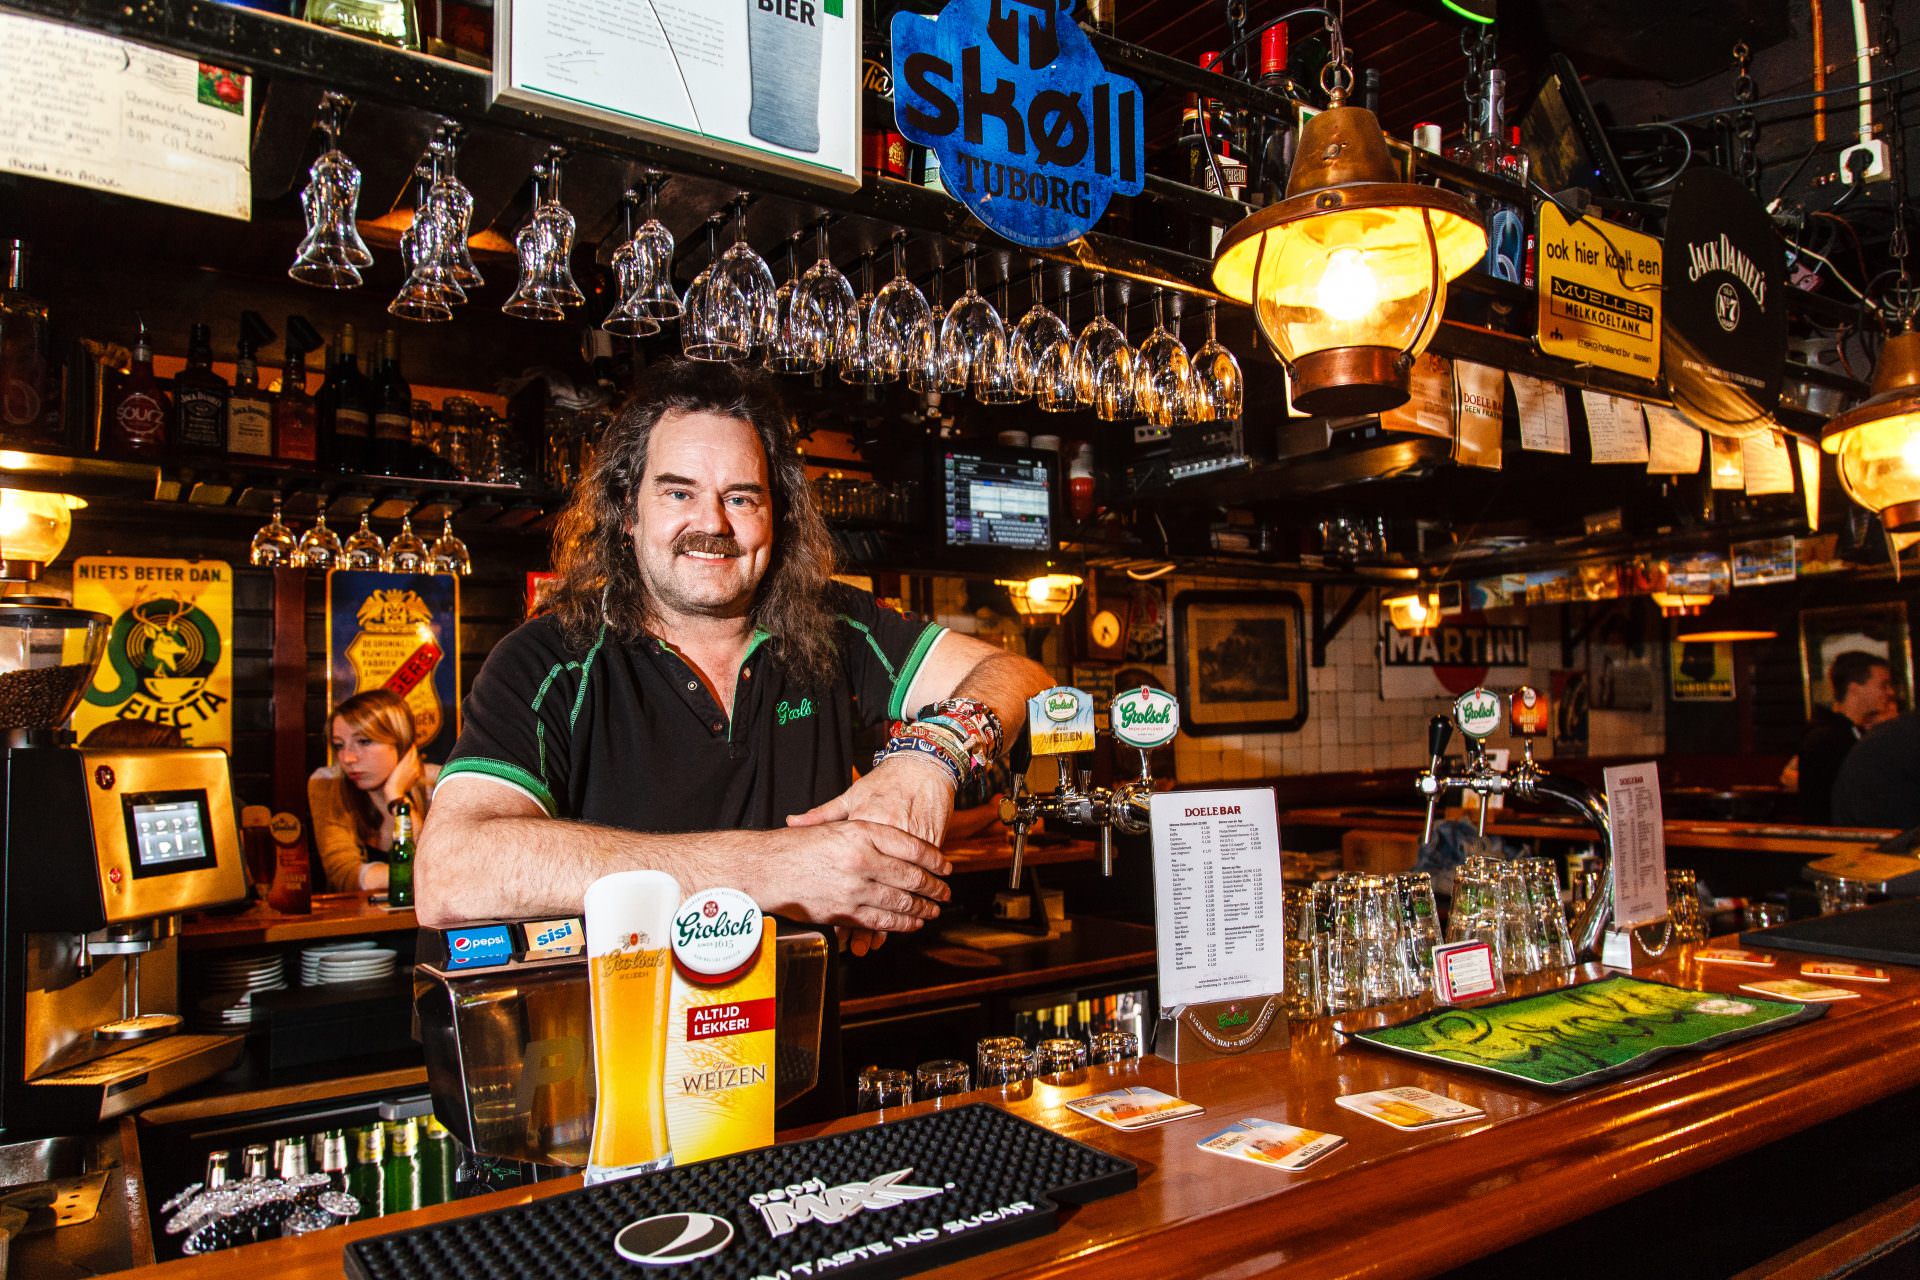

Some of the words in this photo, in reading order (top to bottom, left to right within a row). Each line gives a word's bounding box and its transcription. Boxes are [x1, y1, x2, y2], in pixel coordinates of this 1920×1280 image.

[758, 0, 816, 27] BIER
[957, 152, 1091, 219] TUBORG
[1546, 238, 1569, 260] ook
[1575, 240, 1599, 265] hier
[1638, 260, 1660, 275] een
[1688, 240, 1720, 282] JACK
[1720, 232, 1767, 306] DANIEL'S
[1554, 280, 1651, 319] MUELLER
[1565, 303, 1640, 334] MELKKOELTANK
[79, 565, 129, 580] NIETS
[135, 566, 184, 581] BETER
[1388, 626, 1527, 664] MARTINI
[1120, 701, 1171, 729] Grolsch
[1463, 700, 1495, 724] Grolsch
[472, 935, 504, 948] pepsi
[536, 922, 573, 946] sisi
[676, 908, 755, 947] Grolsch
[694, 1006, 740, 1022] ALTIJD
[694, 1018, 750, 1035] LEKKER!
[683, 1064, 766, 1094] WEIZEN
[791, 1241, 892, 1275] TASTE
[893, 1227, 939, 1248] NO
[943, 1200, 1035, 1234] SUGAR
